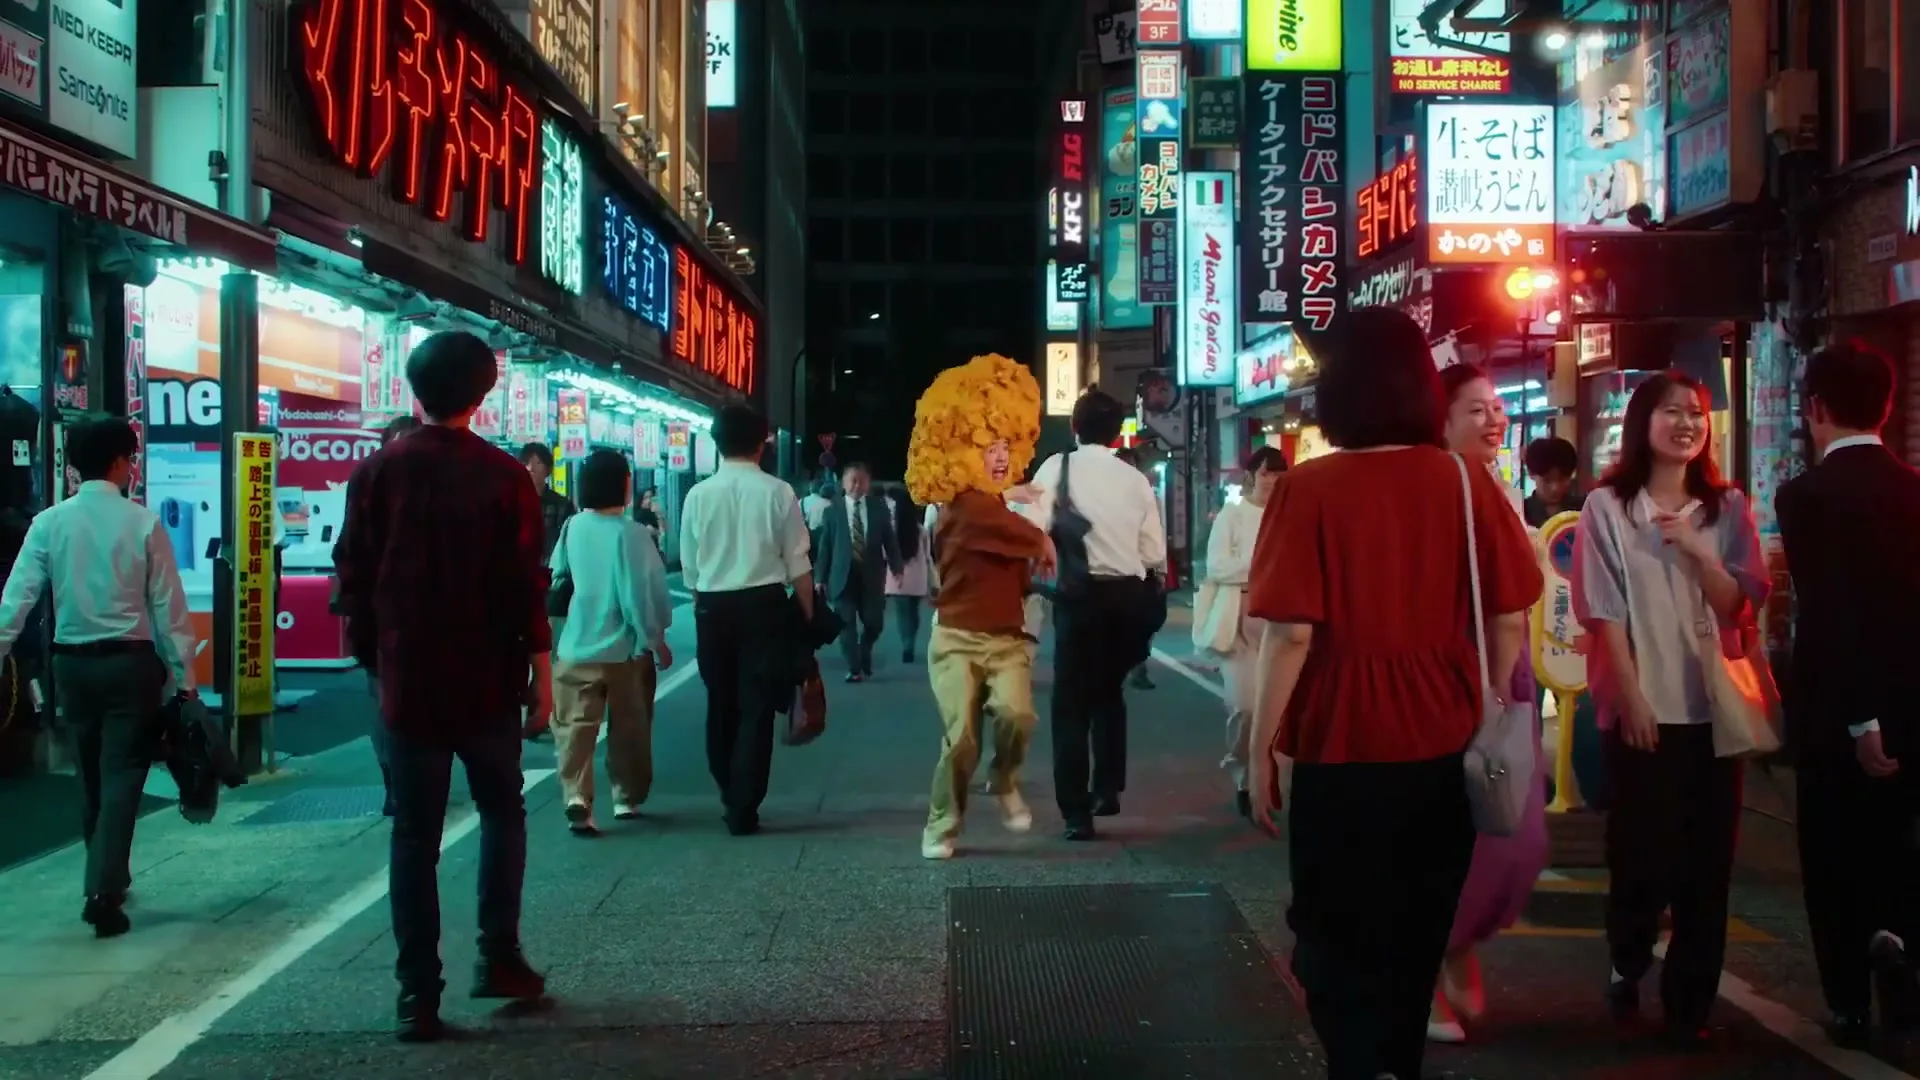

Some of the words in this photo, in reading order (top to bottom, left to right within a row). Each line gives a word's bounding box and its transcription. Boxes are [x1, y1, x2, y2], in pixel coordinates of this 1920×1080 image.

[87, 24, 132, 67] KEEPR
[1149, 26, 1169, 39] 3F
[58, 65, 128, 121] Samsonite
[1399, 79, 1413, 90] NO
[1415, 79, 1458, 90] SERVICE
[1460, 80, 1501, 91] CHARGE
[1436, 114, 1547, 161] 生そば
[0, 140, 99, 213] バシカメラ
[1140, 164, 1158, 215] カメラ
[1159, 141, 1178, 209] ヨドバシ
[1258, 80, 1287, 313] ケータイアクセサリー館
[1436, 168, 1547, 214] 讃岐うどん
[1063, 191, 1082, 244] KFC
[1300, 77, 1338, 331] ヨドバシカメラ
[1438, 228, 1523, 256] かのや
[1203, 232, 1222, 306] Miami
[676, 246, 757, 395] ヨドバシカメラ
[242, 439, 273, 458] 警告
